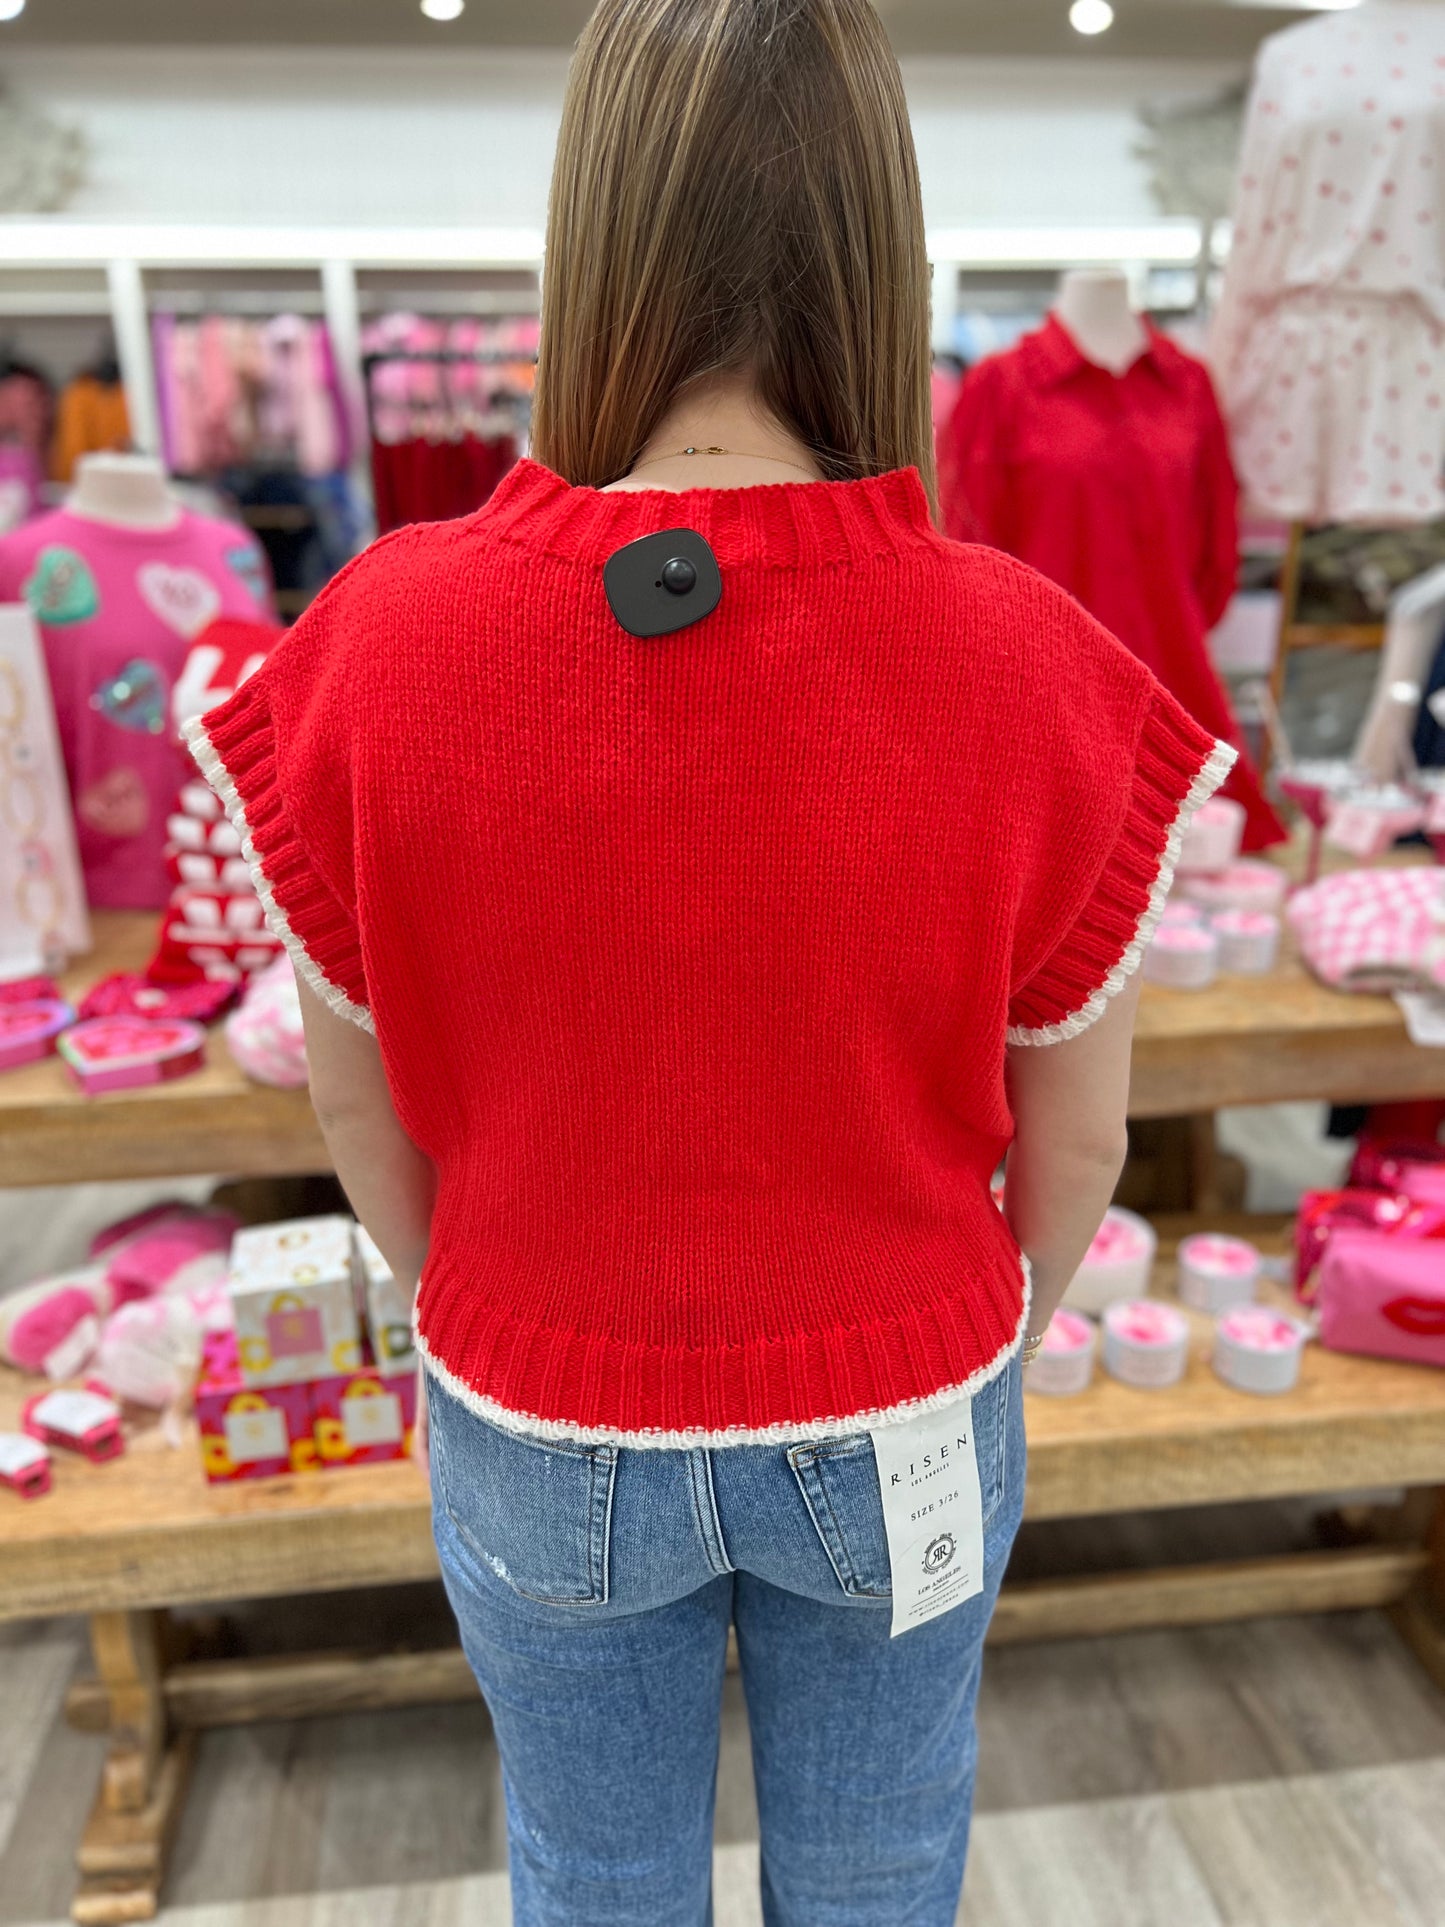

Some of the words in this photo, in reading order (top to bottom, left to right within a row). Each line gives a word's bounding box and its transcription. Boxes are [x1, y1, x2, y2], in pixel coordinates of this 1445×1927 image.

[890, 1433, 968, 1487] RISEN
[910, 1503, 935, 1522] SIZE
[938, 1489, 959, 1507] 3/26
[917, 1584, 931, 1596] LOS
[931, 1565, 962, 1588] ANGELES
